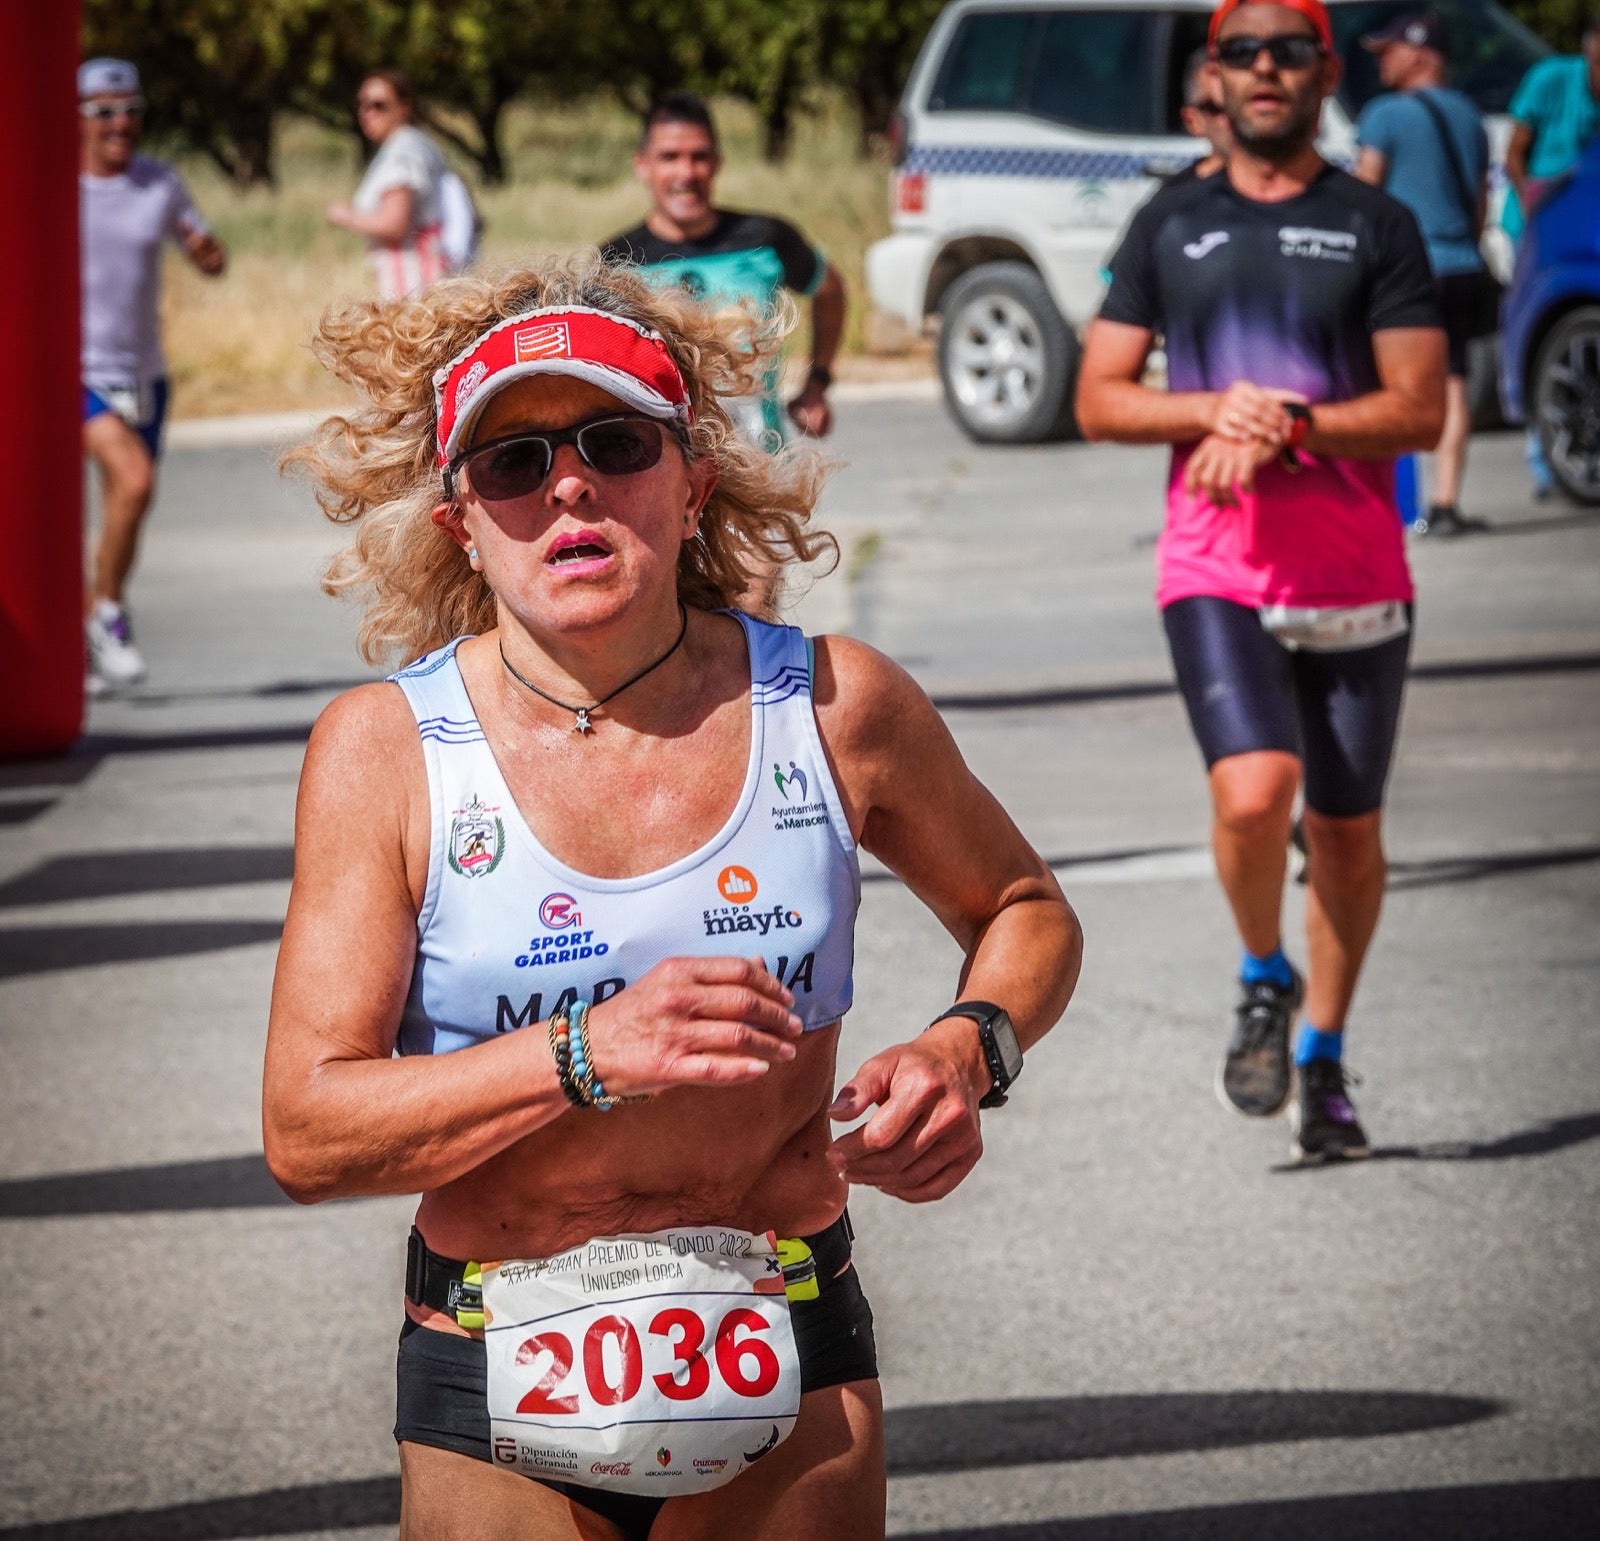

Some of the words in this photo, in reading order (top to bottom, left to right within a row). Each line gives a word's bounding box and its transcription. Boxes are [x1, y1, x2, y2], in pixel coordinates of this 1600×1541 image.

[774, 823, 784, 831] de
[784, 815, 829, 830] Maracen
[703, 905, 750, 919] grupo
[704, 904, 803, 936] mayfo
[529, 930, 594, 951] SPORT
[514, 943, 609, 968] GARRIDO
[547, 1253, 582, 1275] GRAN
[588, 1240, 638, 1267] PREMIO
[646, 1240, 663, 1258] DE
[667, 1233, 714, 1256] FONDO
[719, 1232, 752, 1259] 2022
[581, 1267, 640, 1293] UNIVERSO
[645, 1262, 684, 1281] LORCA
[515, 1307, 780, 1414] 2036
[521, 1446, 578, 1459] Diputación
[521, 1457, 533, 1465] de
[534, 1457, 578, 1470] Granada
